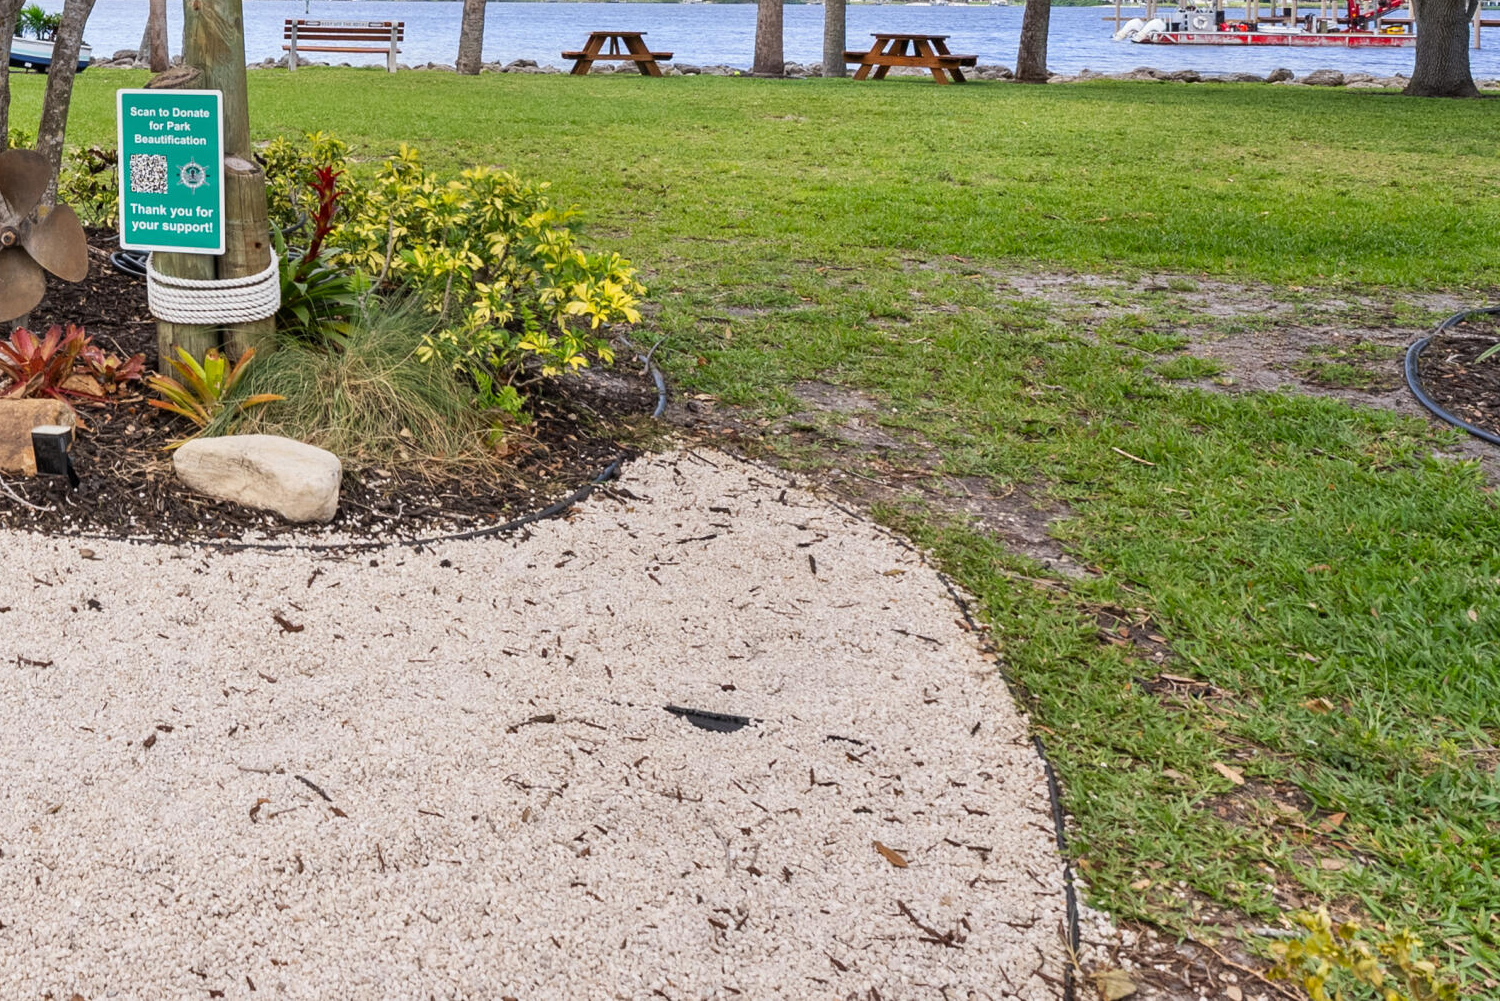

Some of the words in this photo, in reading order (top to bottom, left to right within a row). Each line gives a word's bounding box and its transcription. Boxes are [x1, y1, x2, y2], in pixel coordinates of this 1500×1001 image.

[130, 107, 156, 117] Scan
[159, 107, 170, 117] to
[172, 108, 210, 118] Donate
[149, 121, 164, 130] for
[167, 122, 191, 131] Park
[134, 134, 207, 146] Beautification
[130, 203, 167, 215] Thank
[170, 208, 193, 218] you
[196, 206, 214, 217] for
[132, 221, 159, 231] your
[162, 222, 213, 233] support!
